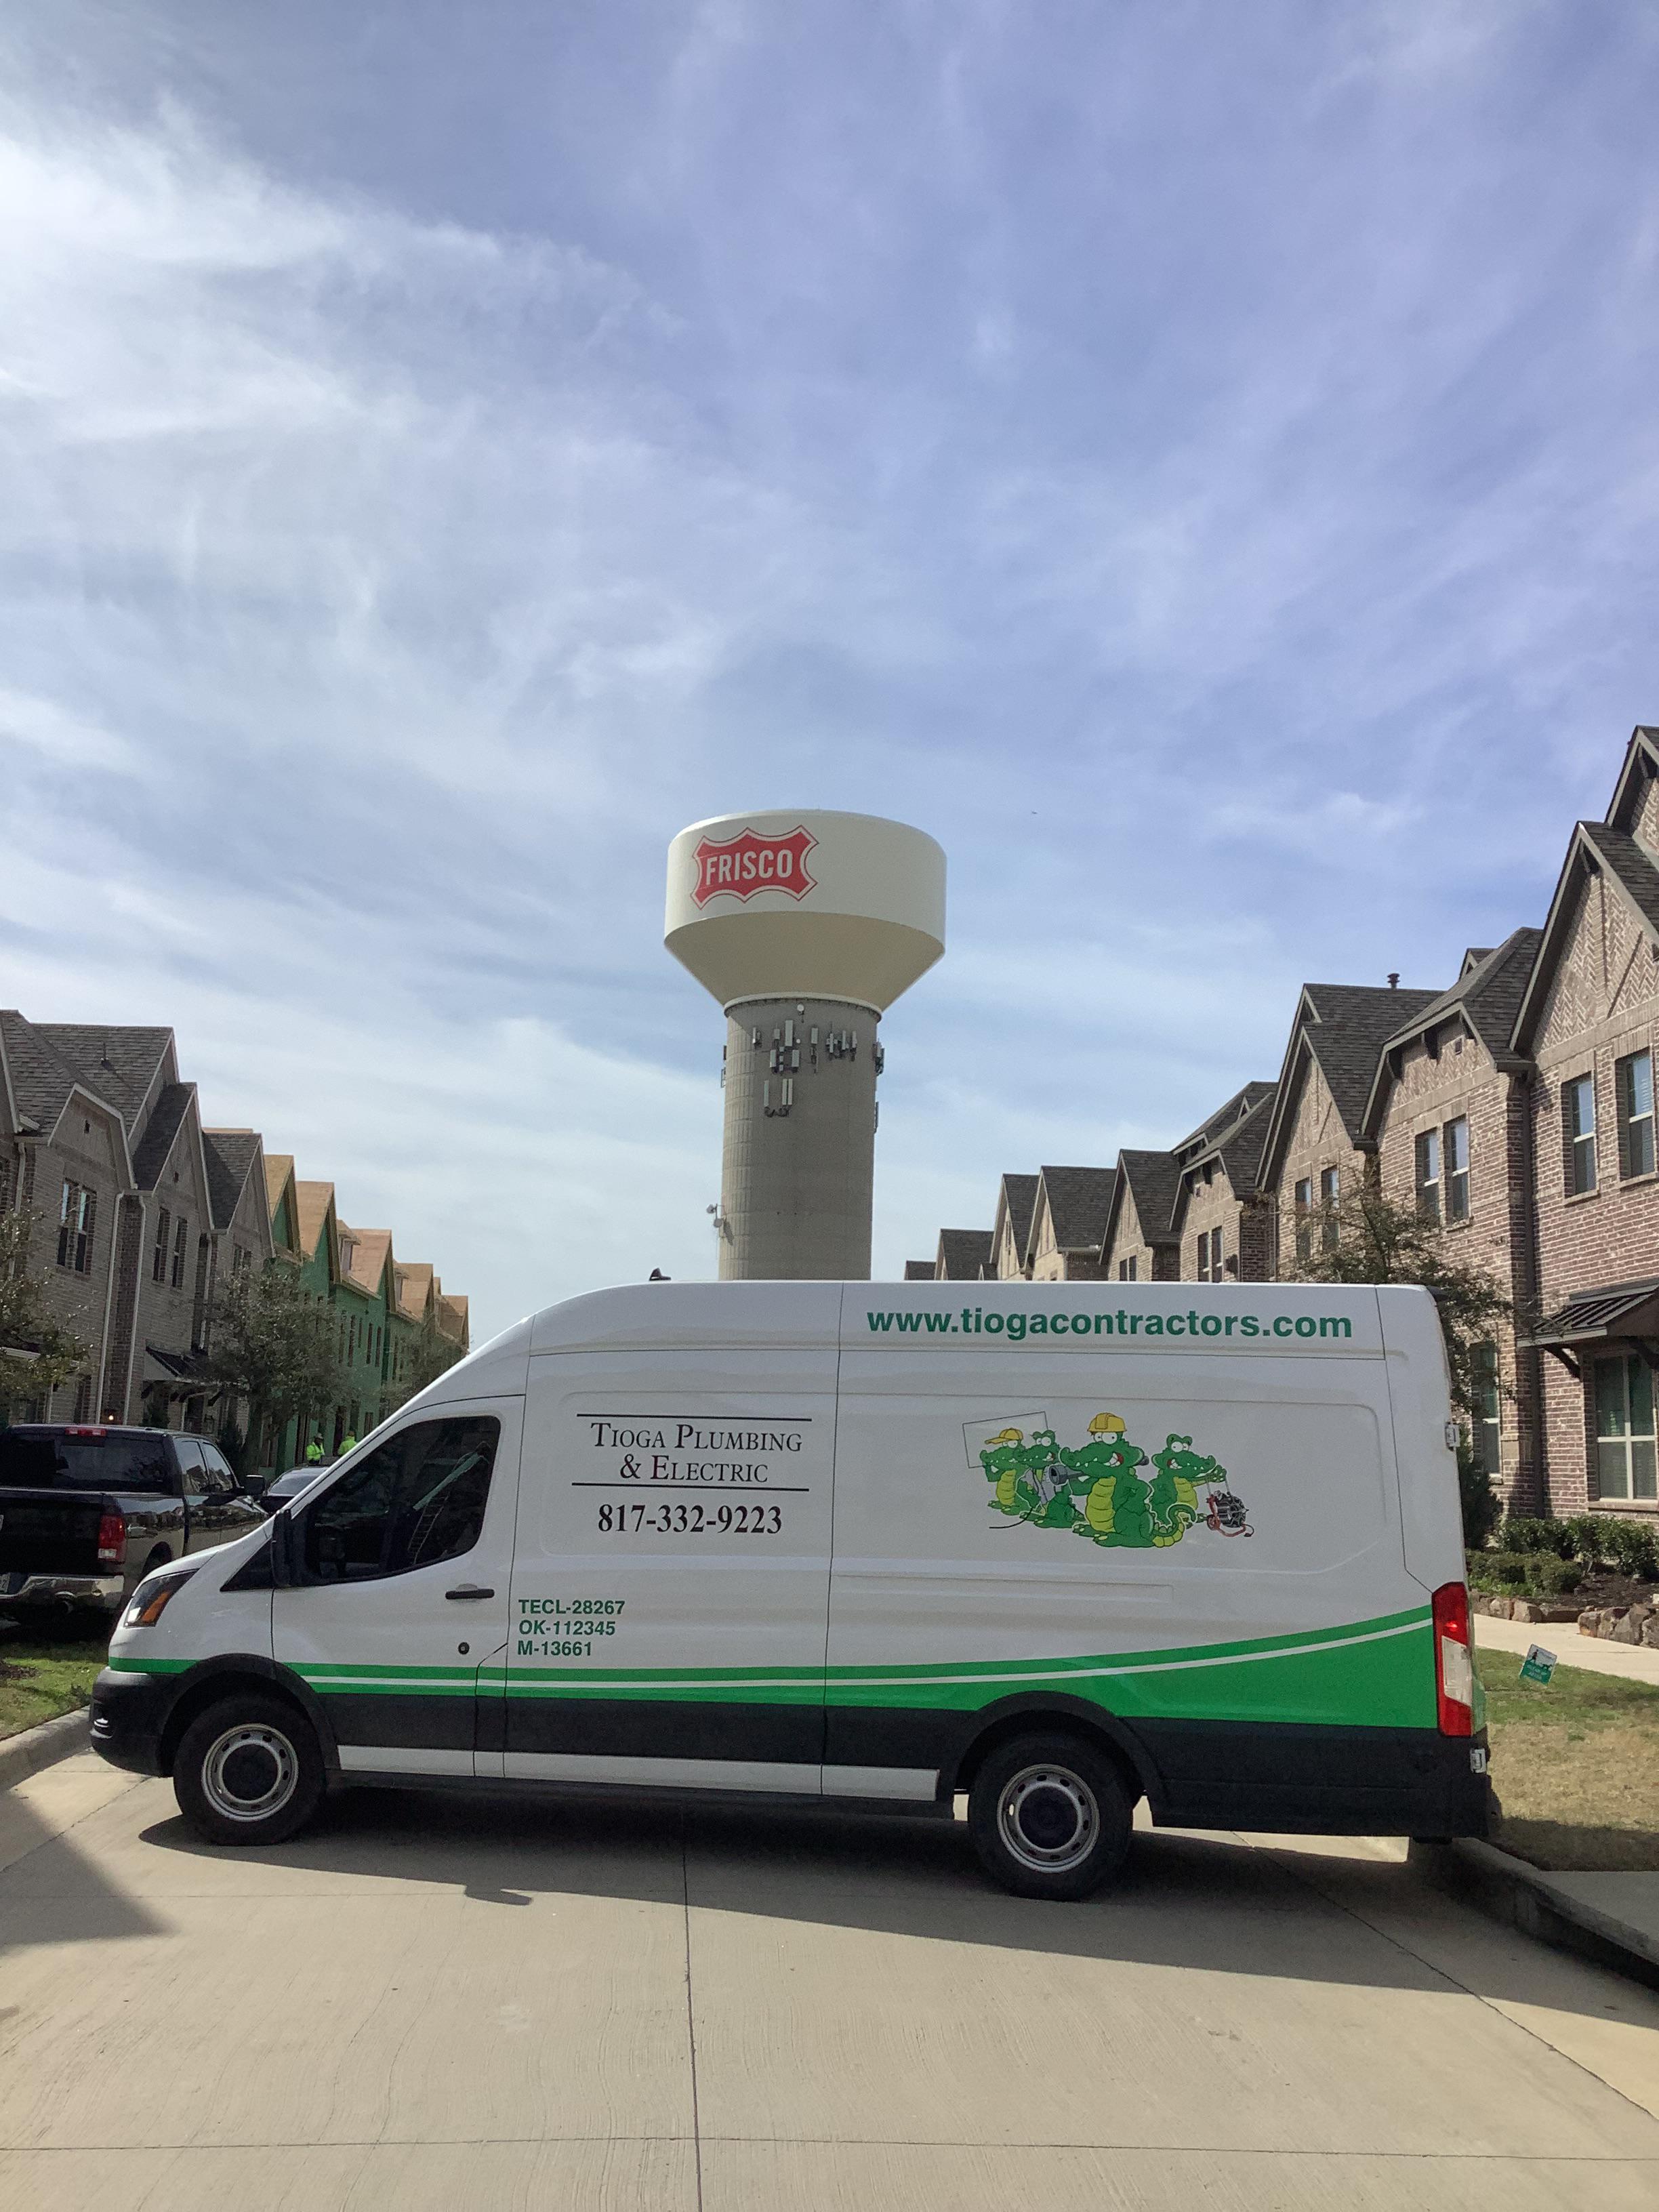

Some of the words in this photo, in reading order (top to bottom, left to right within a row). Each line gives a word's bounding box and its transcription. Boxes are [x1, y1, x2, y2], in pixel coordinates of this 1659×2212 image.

[705, 848, 794, 885] FRISCO
[867, 1307, 1352, 1340] www.tiogacontractors.com
[619, 1453, 642, 1479] &
[598, 1503, 783, 1534] 817-332-9223
[518, 1599, 626, 1615] TECL-28267
[518, 1619, 616, 1635] OK-112345
[517, 1639, 592, 1656] M-13661
